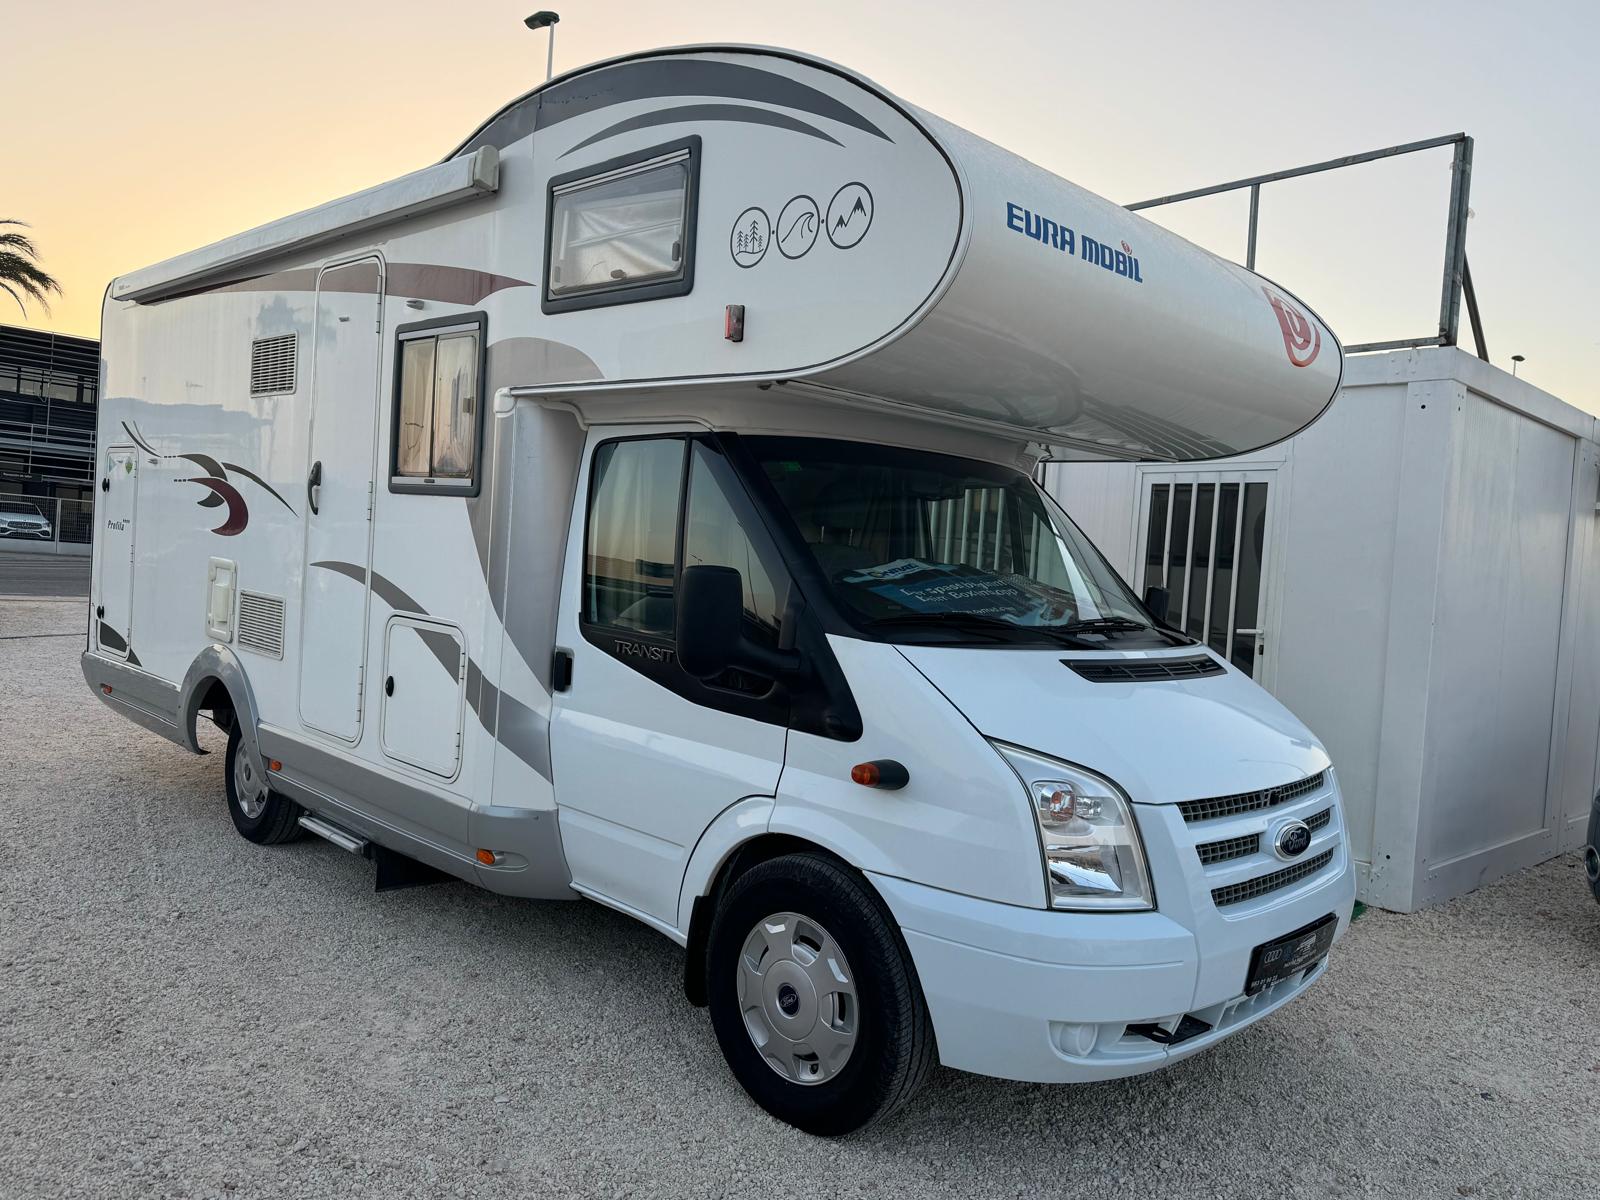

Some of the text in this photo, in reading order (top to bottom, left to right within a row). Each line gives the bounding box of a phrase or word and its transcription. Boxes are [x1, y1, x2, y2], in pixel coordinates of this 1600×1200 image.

[1006, 201, 1076, 255] EURA
[614, 639, 674, 663] TRANSIT
[1288, 829, 1308, 851] Ford
